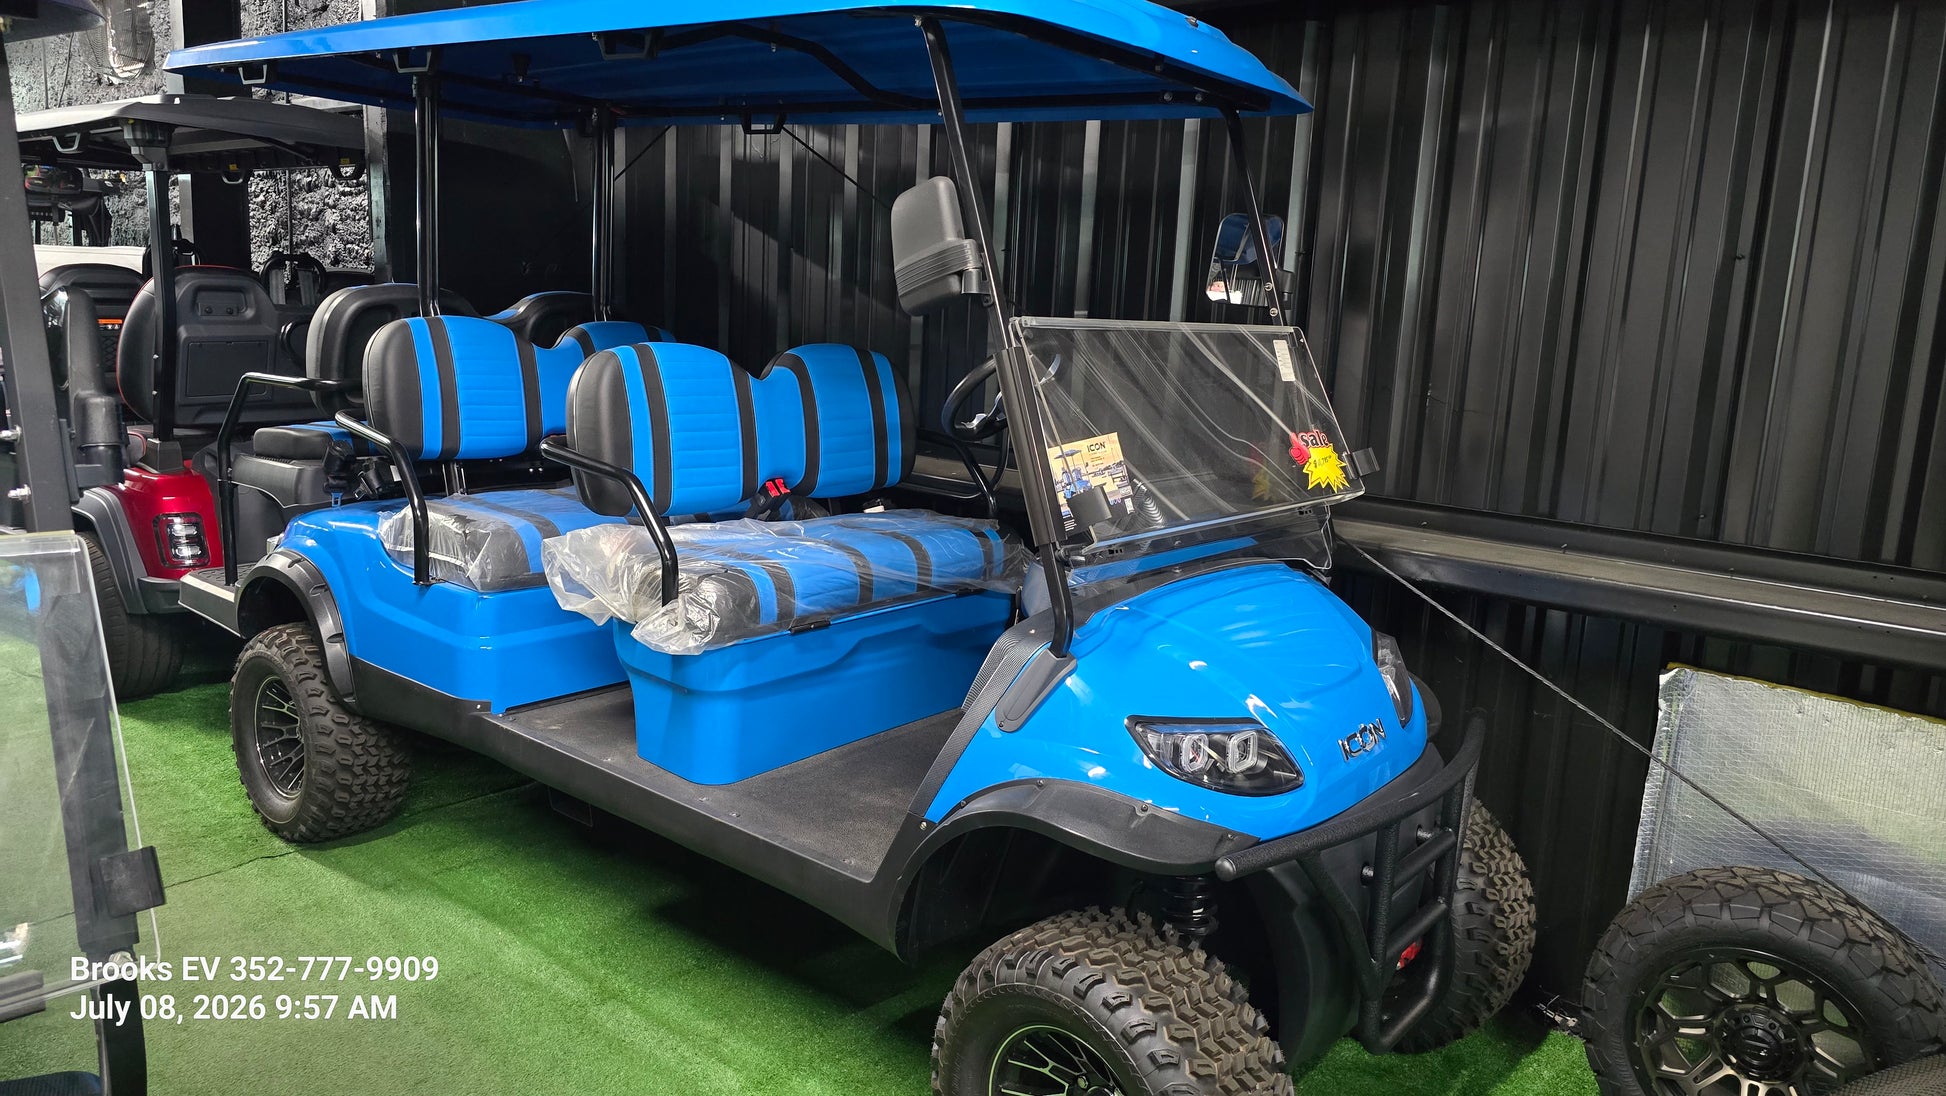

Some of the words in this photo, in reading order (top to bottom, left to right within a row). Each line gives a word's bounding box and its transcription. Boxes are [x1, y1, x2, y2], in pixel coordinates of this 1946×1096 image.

[1087, 442, 1106, 453] ICON
[1300, 430, 1329, 448] sale
[1337, 718, 1387, 762] ICON
